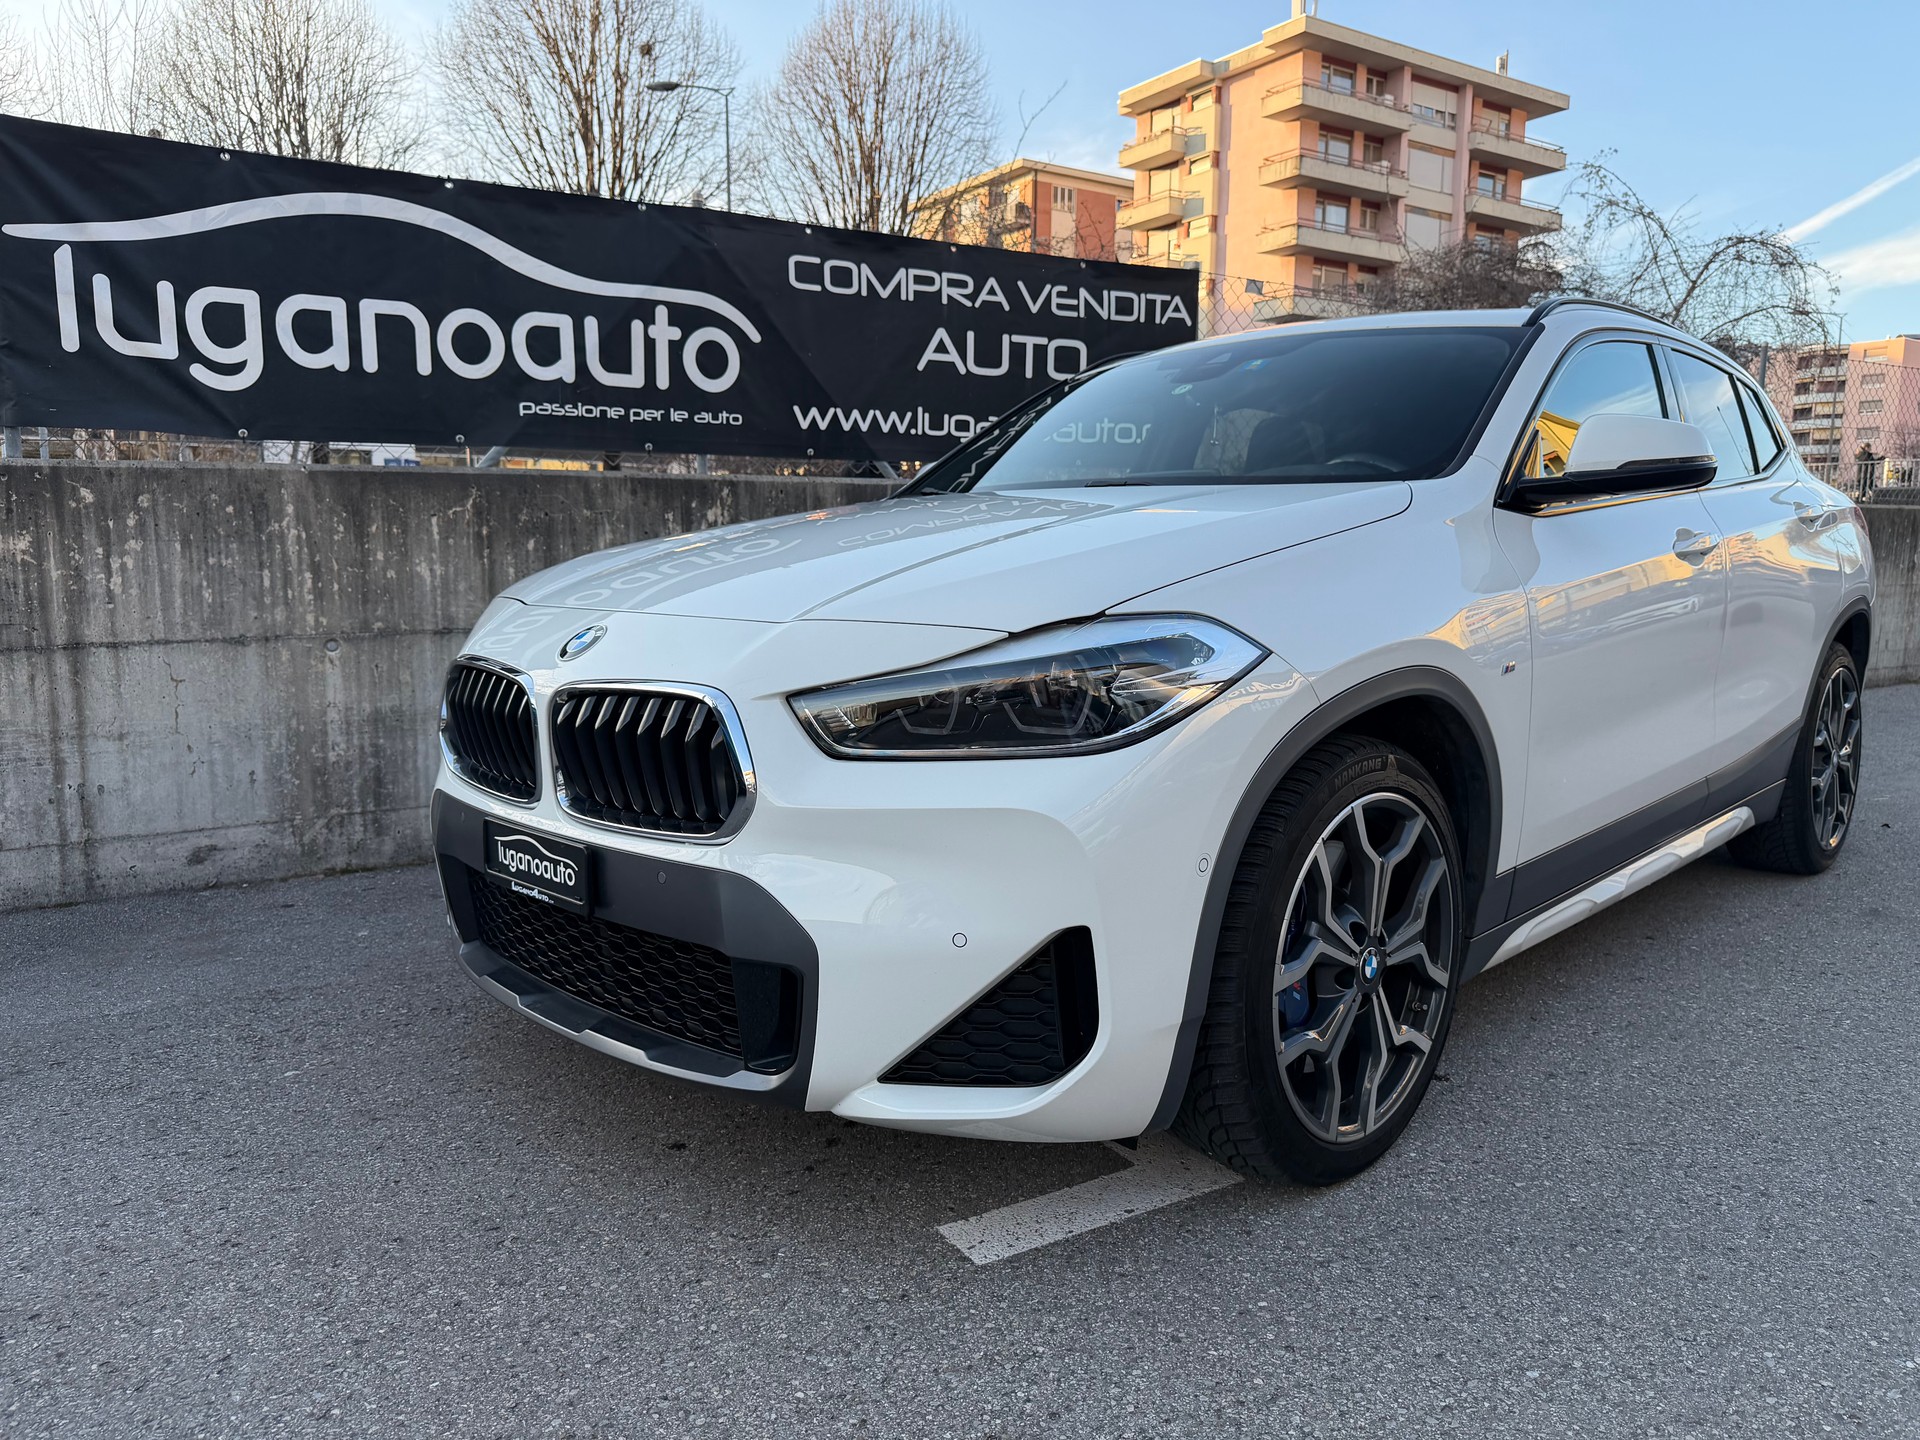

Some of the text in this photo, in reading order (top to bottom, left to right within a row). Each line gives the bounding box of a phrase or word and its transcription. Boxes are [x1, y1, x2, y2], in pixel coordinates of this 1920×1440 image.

[788, 254, 1192, 327] COMPRA VENDITA
[54, 244, 741, 393] luganoauto
[917, 327, 1087, 380] AUTO
[519, 402, 743, 425] passione per le auto
[1334, 757, 1383, 790] NANKANG
[497, 841, 576, 887] luganoauto
